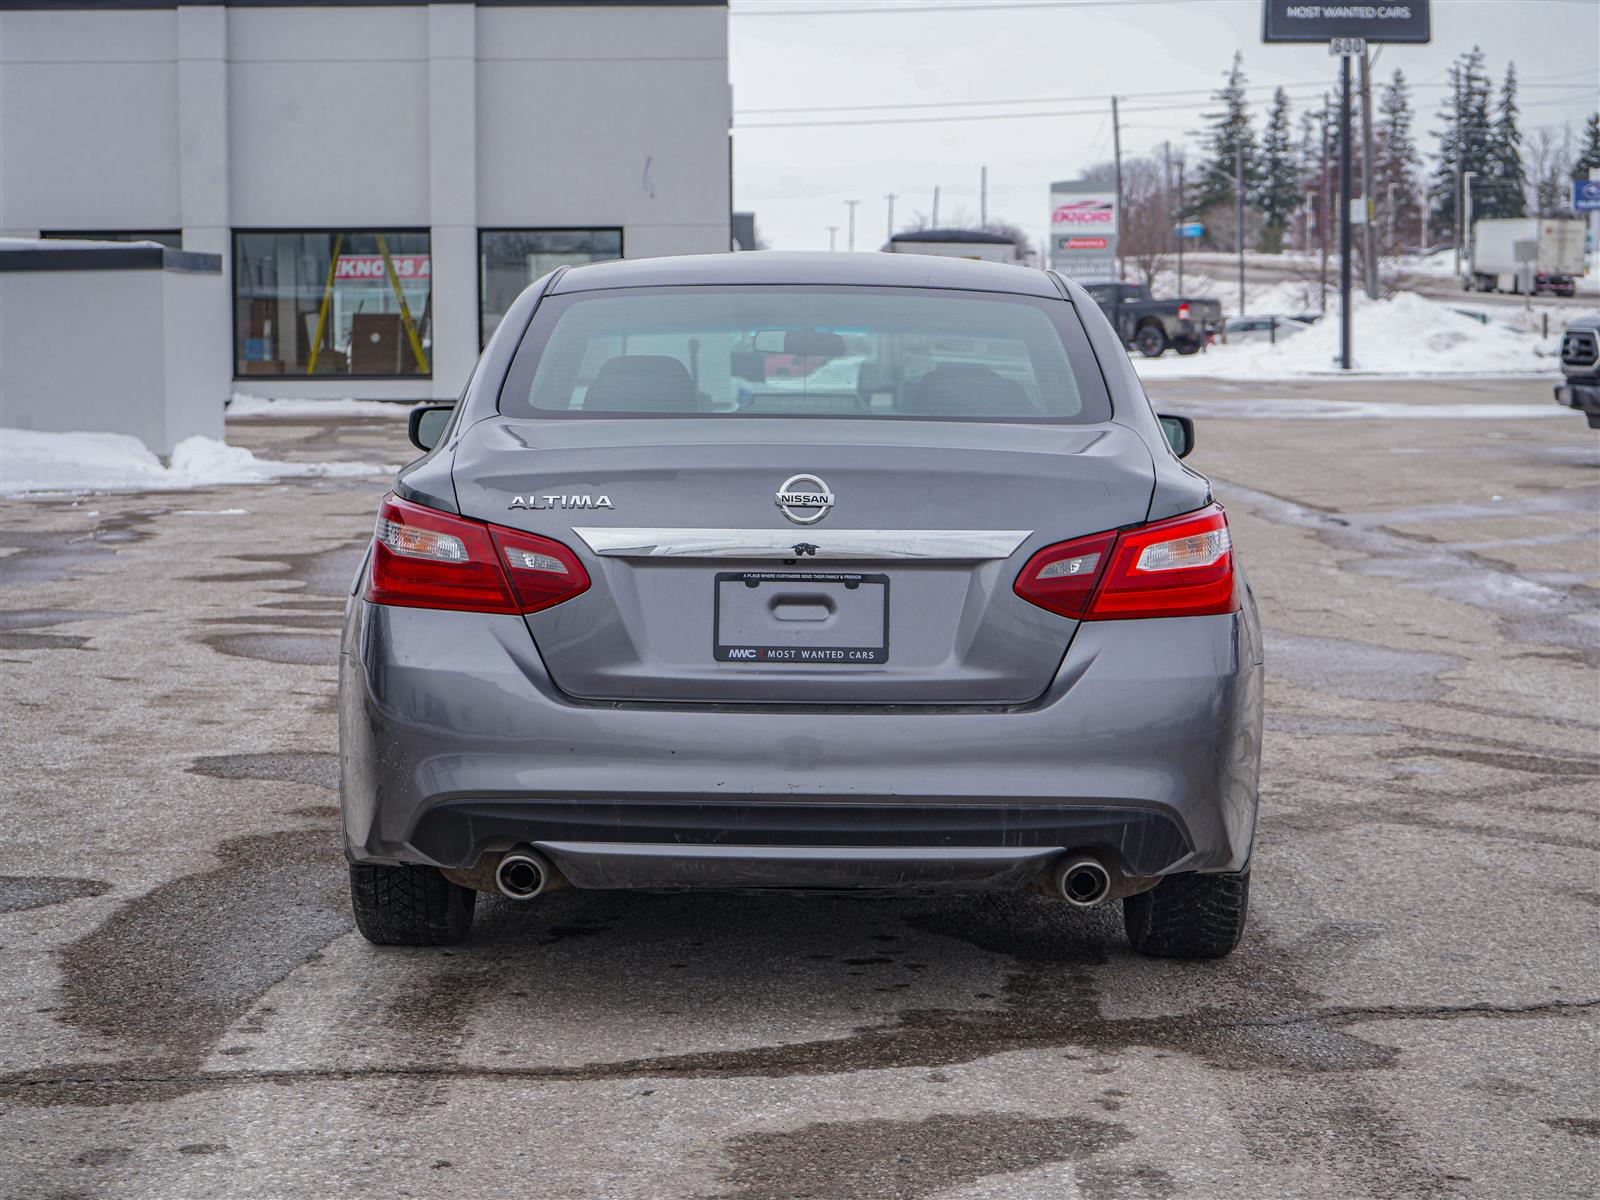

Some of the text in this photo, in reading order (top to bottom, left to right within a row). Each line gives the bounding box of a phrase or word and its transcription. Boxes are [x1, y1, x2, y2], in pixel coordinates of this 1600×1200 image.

[1286, 6, 1411, 19] MOST WANTED CARS
[508, 495, 615, 510] ALTIMA
[781, 495, 829, 503] NISSAN
[767, 650, 796, 658] MOST
[801, 650, 844, 659] WANTED
[849, 651, 875, 659] CARS
